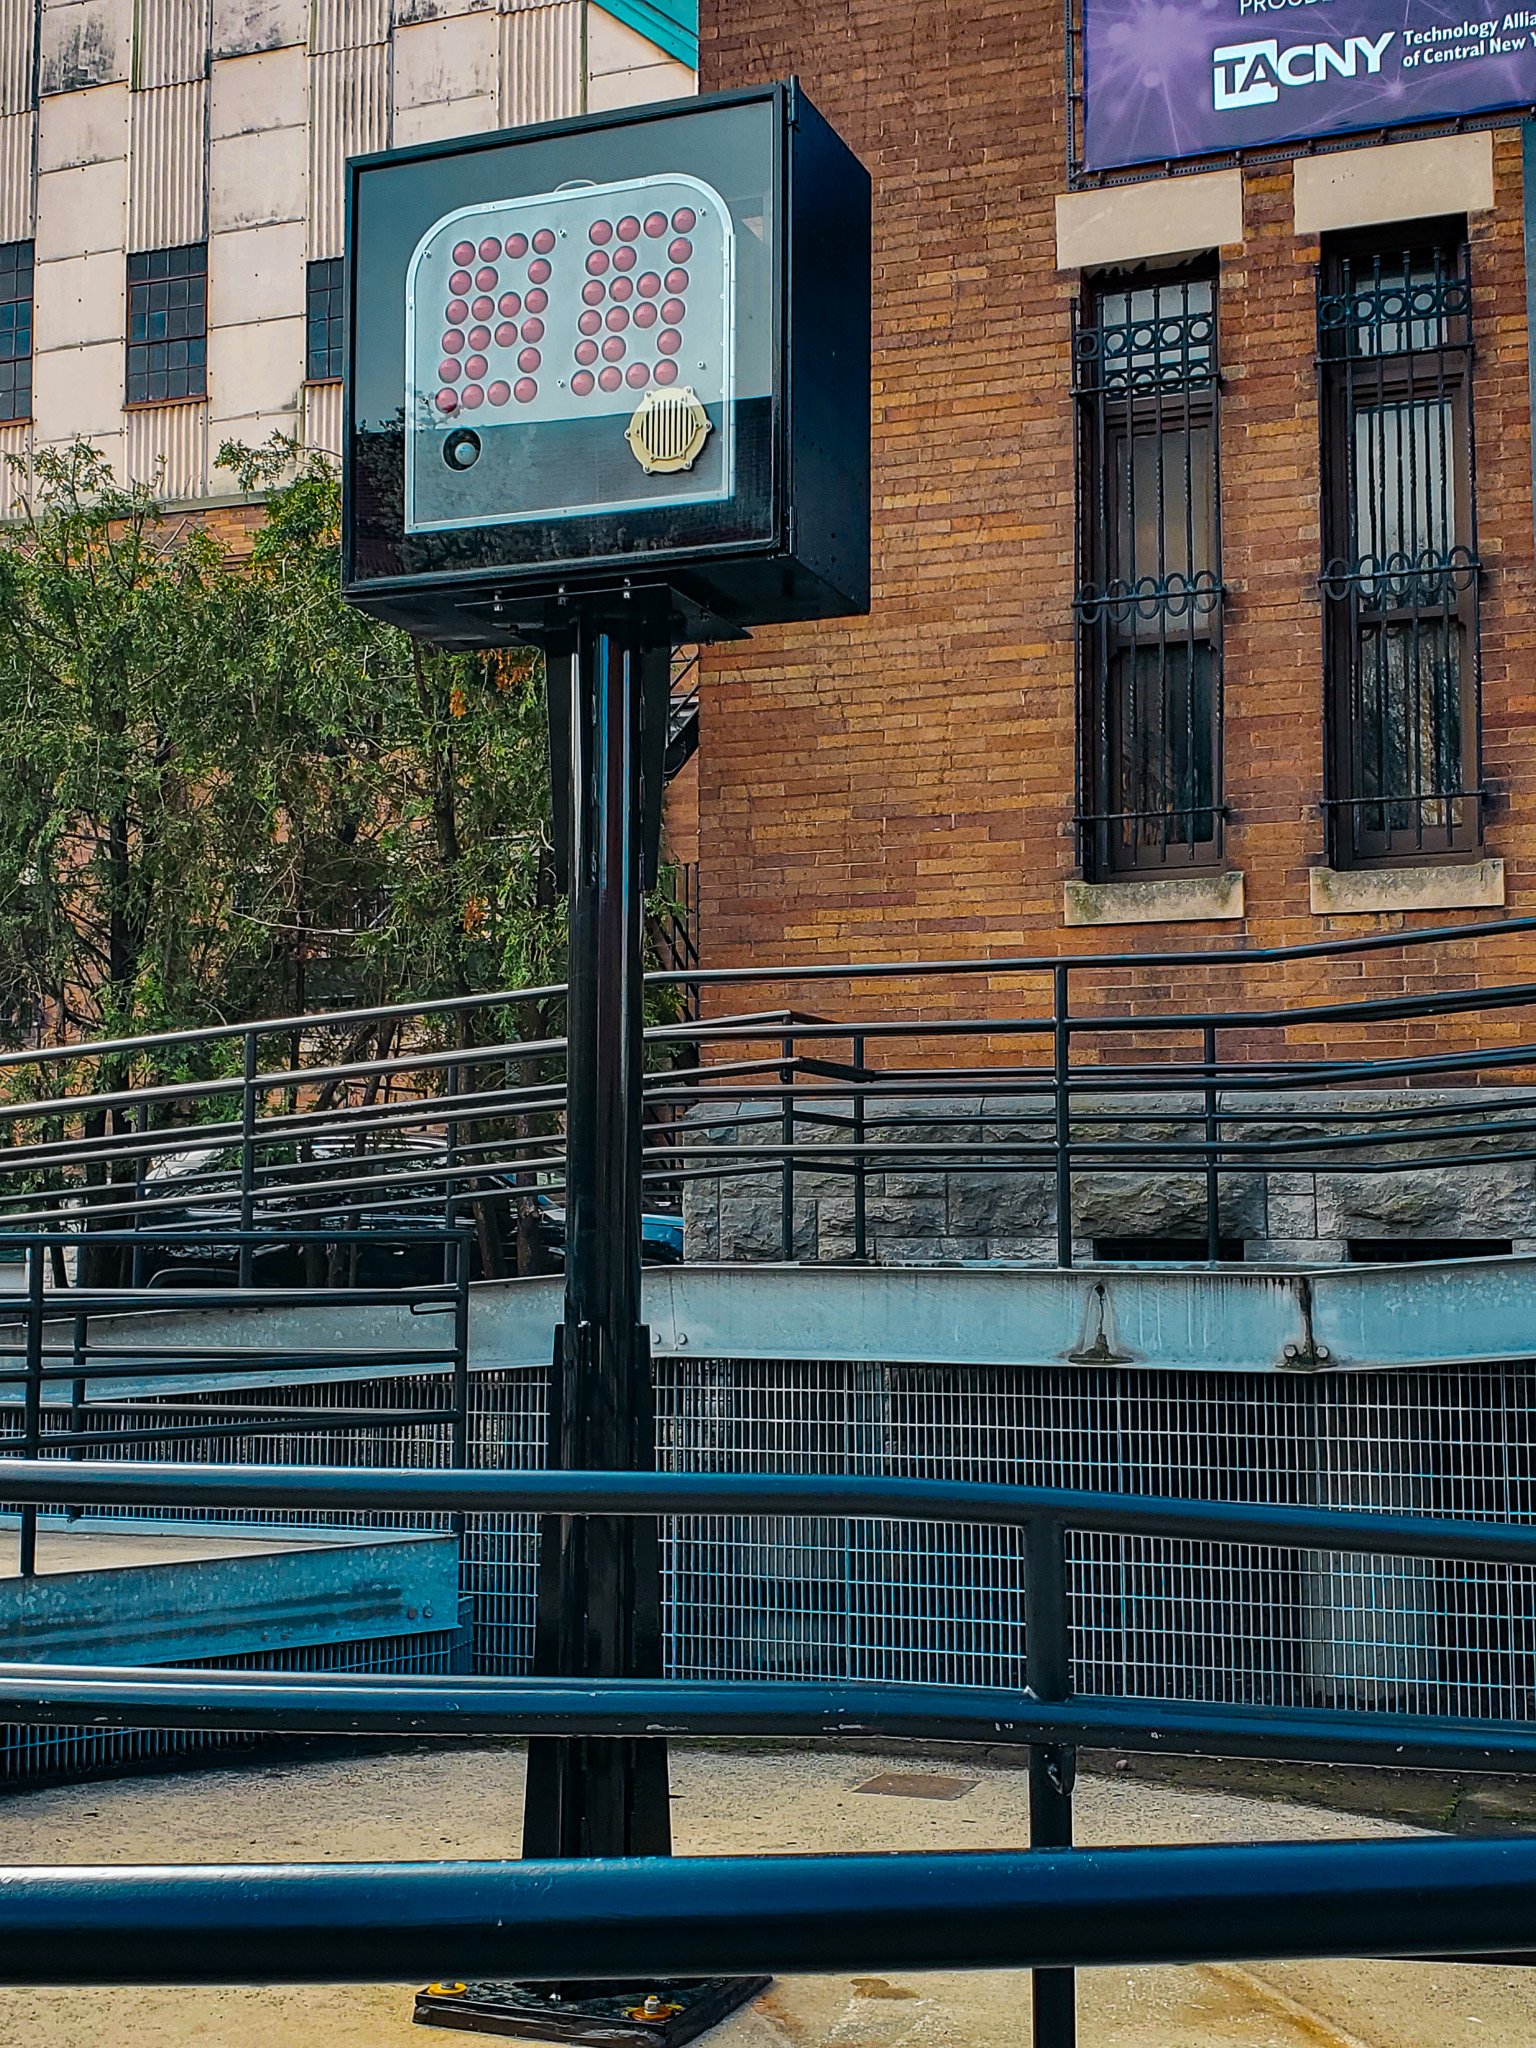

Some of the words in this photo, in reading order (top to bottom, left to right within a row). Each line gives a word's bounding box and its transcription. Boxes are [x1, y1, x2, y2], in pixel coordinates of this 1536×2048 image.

[1402, 21, 1499, 46] Technology
[1402, 49, 1421, 67] of
[1423, 40, 1485, 64] Central
[1489, 37, 1527, 54] New
[1213, 31, 1396, 106] TACNY
